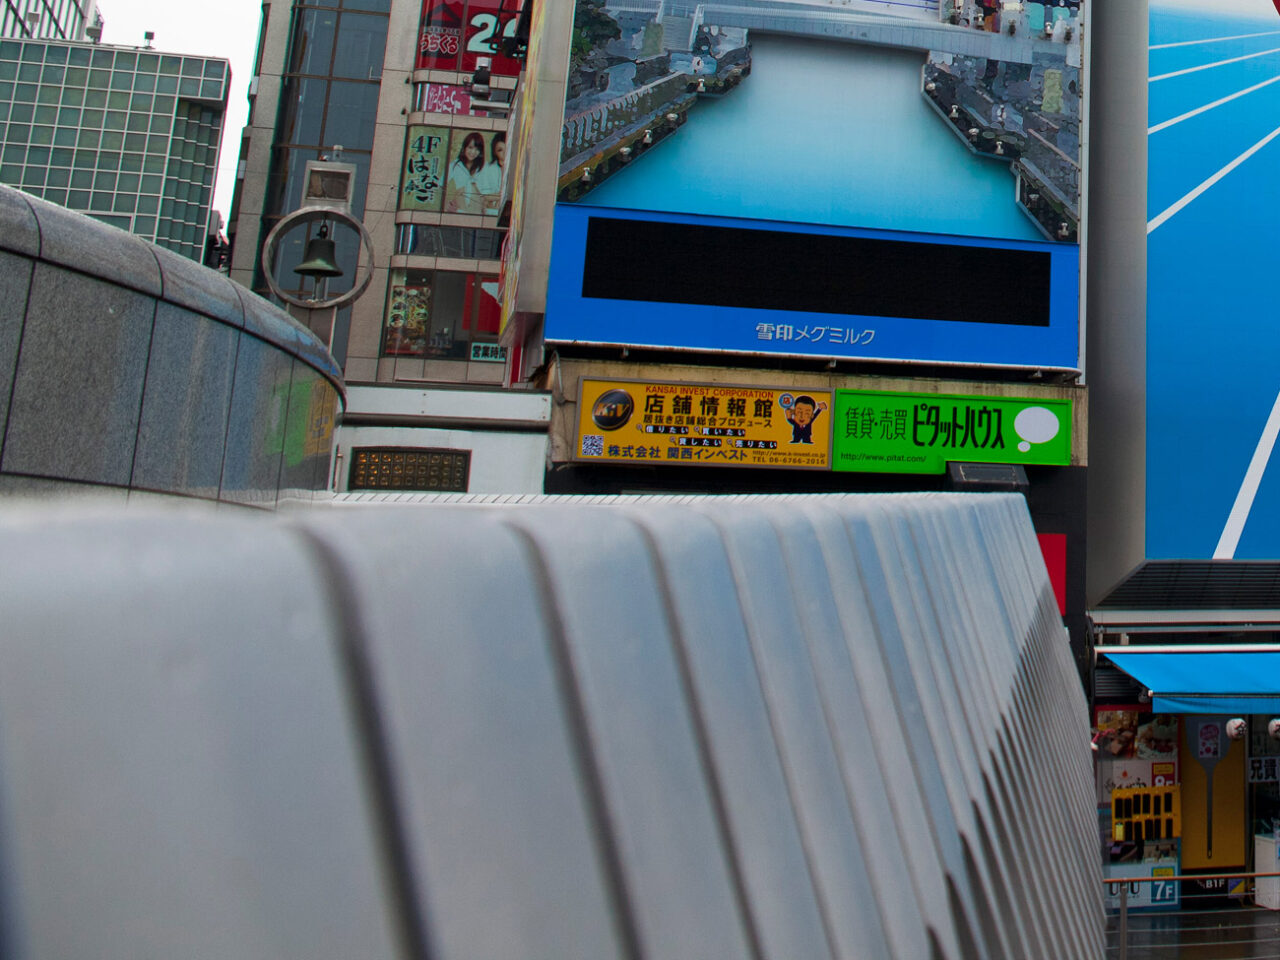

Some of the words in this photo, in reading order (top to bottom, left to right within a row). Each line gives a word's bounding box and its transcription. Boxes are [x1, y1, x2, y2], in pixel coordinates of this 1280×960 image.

[411, 135, 441, 153] 4F
[756, 322, 876, 345] 雪印メグミルク
[645, 386, 678, 395] KANSAI
[680, 387, 711, 396] INVEST
[713, 388, 774, 399] CORPORATION
[644, 393, 774, 419] 店舗情報館
[643, 414, 773, 429] 居抜き店舗総合プロデュース
[912, 402, 1005, 450] ピタットハウス
[645, 425, 688, 435] 借りたい
[702, 427, 746, 437] 買いたい
[735, 439, 777, 449] 売りたい
[607, 444, 662, 459] 株式会社
[667, 446, 748, 461] 関西インベスト
[752, 456, 767, 464] TEL
[840, 452, 927, 463] http://www.pitat.com/
[1153, 881, 1174, 901] 7F
[1205, 878, 1225, 889] B1F
